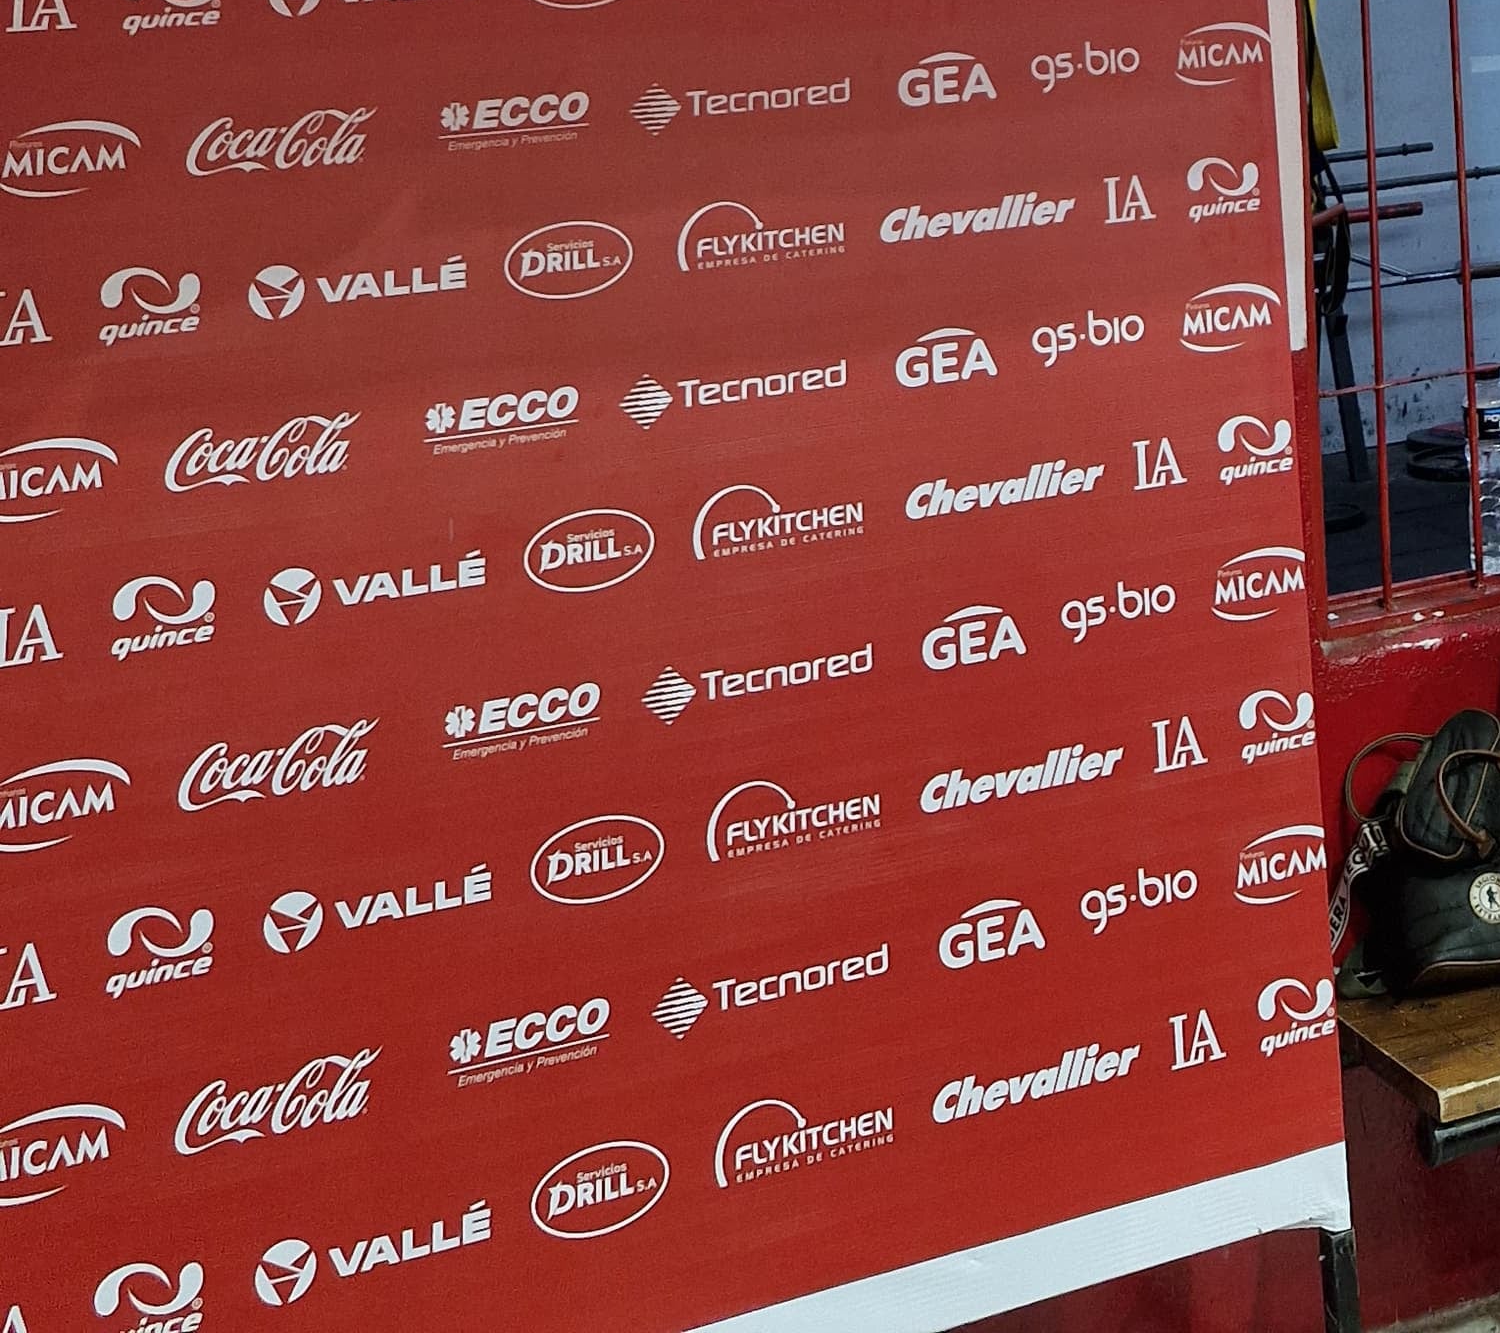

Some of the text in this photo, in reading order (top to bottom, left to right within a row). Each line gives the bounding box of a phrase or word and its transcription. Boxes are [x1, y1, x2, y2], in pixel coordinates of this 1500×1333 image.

[122, 6, 220, 36] quince
[1177, 41, 1263, 70] MICAM
[685, 76, 851, 117] Tecnored
[897, 63, 997, 107] GEA
[472, 91, 590, 130] ECCO
[1, 140, 126, 179] MICAM
[185, 107, 377, 177] Coca-Cola
[448, 138, 510, 151] Emergencia
[511, 137, 519, 148] y
[879, 191, 1076, 243] Chevallier
[1103, 174, 1157, 224] LA
[1189, 195, 1260, 224] quince
[519, 248, 601, 280] DRILL
[697, 221, 845, 259] FLYKITCHEN
[698, 246, 845, 270] EMPRESA DE CATERING
[315, 254, 467, 303] VALLÉ
[98, 313, 200, 347] quince
[1182, 301, 1272, 337] MICAM
[676, 359, 847, 408] Tecnored
[895, 338, 998, 388] GEA
[459, 386, 579, 431] ECCO
[164, 411, 361, 492] Coca-Cola
[433, 439, 497, 455] Emergencia
[498, 438, 506, 449] y
[1132, 437, 1188, 491] LA
[1219, 455, 1294, 485] quince
[905, 459, 1105, 520] Chevallier
[713, 501, 864, 545] FLYKITCHEN
[713, 525, 864, 558] EMPRESA DE CATERING
[332, 549, 486, 606] VALLÉ
[539, 537, 622, 574] DRILL
[1214, 565, 1305, 606] MICAM
[111, 624, 215, 661] quince
[921, 615, 1027, 670] GEA
[700, 642, 873, 700] Tecnored
[478, 682, 600, 735] ECCO
[177, 718, 379, 812] Coca-Cola
[452, 739, 516, 760] Emergencia
[518, 739, 527, 751] y
[1151, 715, 1209, 774] LA
[1241, 722, 1316, 765] quince
[919, 743, 1124, 813] Chevallier
[726, 793, 881, 847] FLYKITCHEN
[727, 817, 881, 858] EMPRESA DE CATERING
[546, 844, 631, 886] DRILL
[1237, 838, 1327, 889] MICAM
[334, 863, 492, 929] VALLÉ
[938, 906, 1046, 969] GEA
[105, 956, 213, 999] quince
[711, 943, 889, 1011] Tecnored
[485, 997, 610, 1058] ECCO
[1168, 1009, 1227, 1071] LA
[1260, 1018, 1336, 1057] quince
[458, 1062, 524, 1088] Emergencia
[526, 1060, 535, 1074] y
[932, 1043, 1141, 1123] Chevallier
[174, 1046, 383, 1155] Coca-Cola
[734, 1106, 893, 1170] FLYKITCHEN
[735, 1132, 894, 1183] EMPRESA DE CATERING
[545, 1169, 638, 1224] DRILL
[328, 1199, 491, 1277] VALLÉ
